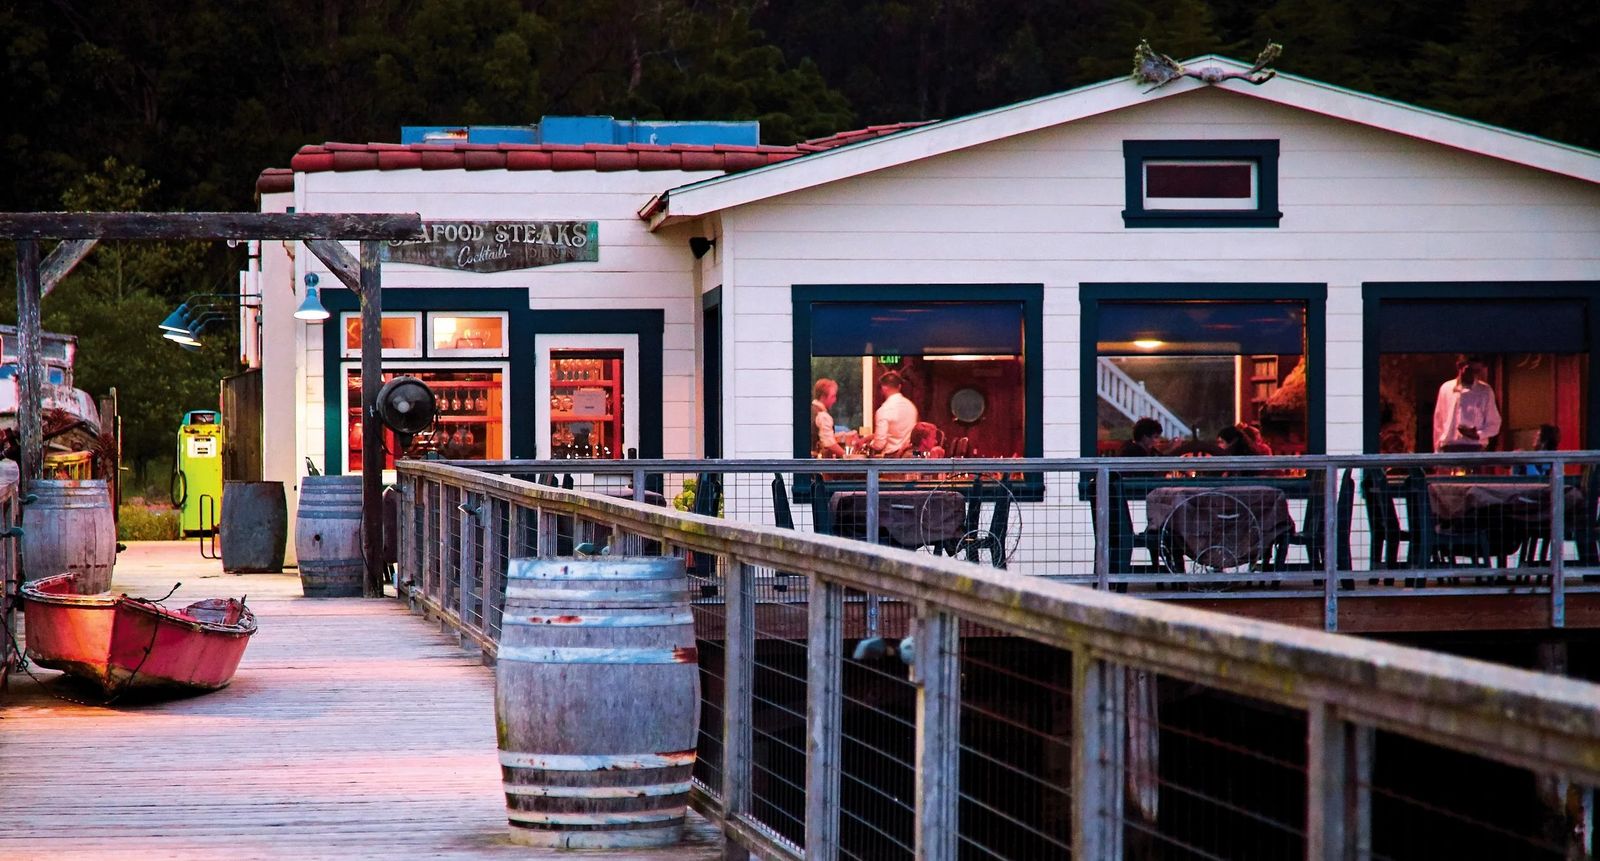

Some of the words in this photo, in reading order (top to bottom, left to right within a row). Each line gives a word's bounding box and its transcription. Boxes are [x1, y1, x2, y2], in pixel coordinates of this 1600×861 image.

[388, 223, 484, 246] AFOOD
[495, 223, 587, 247] STEAKS
[457, 245, 511, 267] Cocktails
